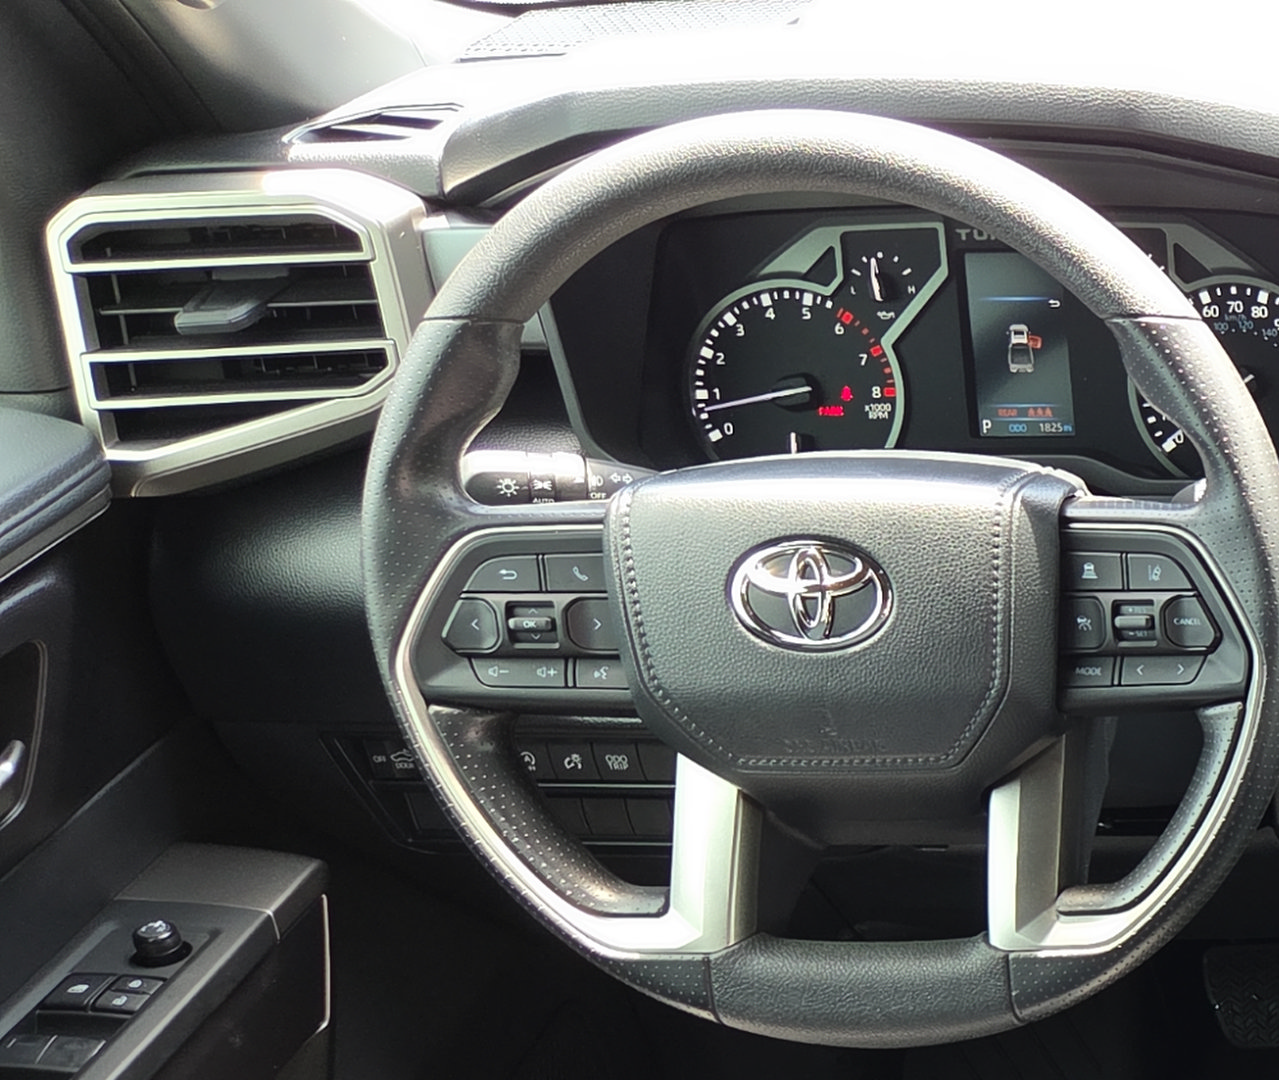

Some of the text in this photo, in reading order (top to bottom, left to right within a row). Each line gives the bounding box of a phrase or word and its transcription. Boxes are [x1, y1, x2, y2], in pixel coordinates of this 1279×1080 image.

[1202, 305, 1219, 318] 60
[1226, 300, 1244, 313] 70
[1250, 305, 1268, 319] 80
[765, 307, 776, 320] 4
[802, 307, 812, 320] 5
[736, 323, 745, 336] 3
[834, 322, 845, 335] 6
[715, 353, 726, 365] 2
[858, 354, 868, 366] 7
[712, 387, 721, 401] 1
[872, 386, 882, 398] 8
[723, 422, 734, 435] 0
[982, 419, 992, 434] P
[1039, 422, 1064, 433] 1825
[522, 619, 537, 629] OK
